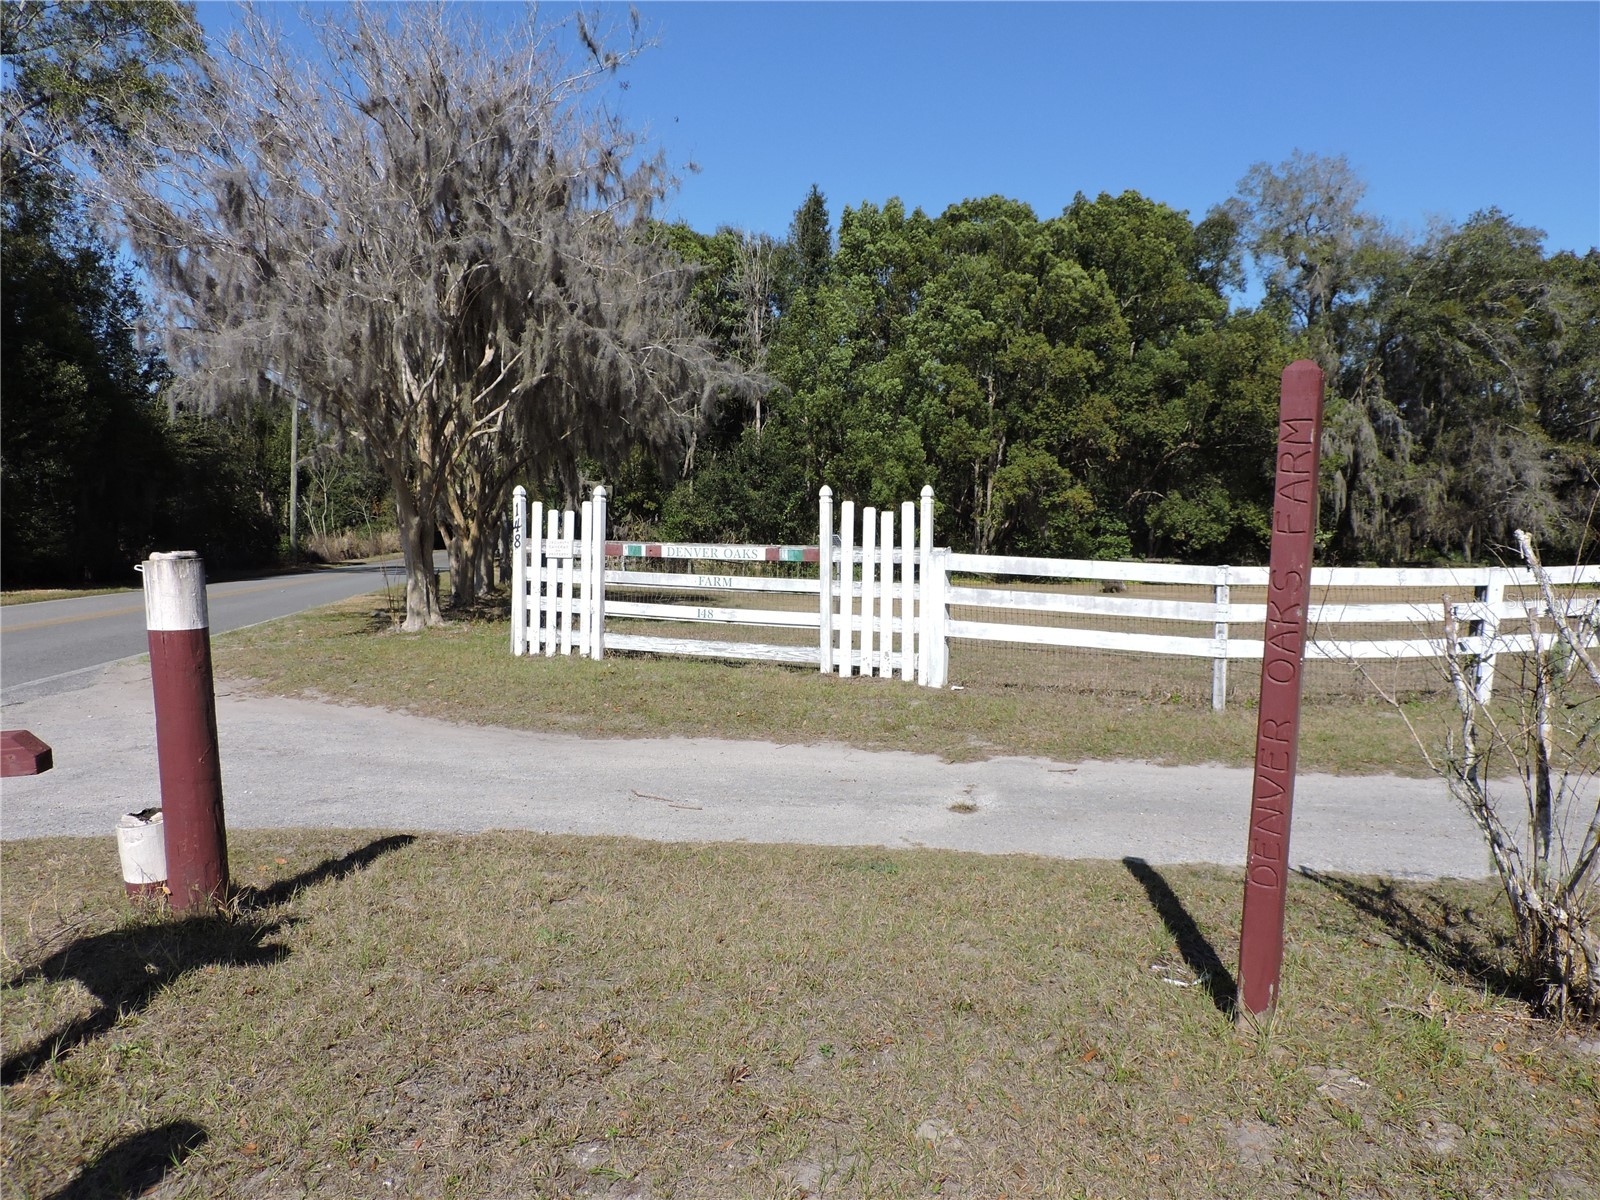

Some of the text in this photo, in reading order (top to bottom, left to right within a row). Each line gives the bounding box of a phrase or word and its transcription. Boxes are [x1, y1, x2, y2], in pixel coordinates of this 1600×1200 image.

[513, 502, 522, 549] 148
[667, 546, 758, 560] DENVER OAKS
[698, 576, 733, 587] FARM
[697, 608, 714, 619] 148
[1251, 418, 1314, 888] DENVER OAKS FARM
